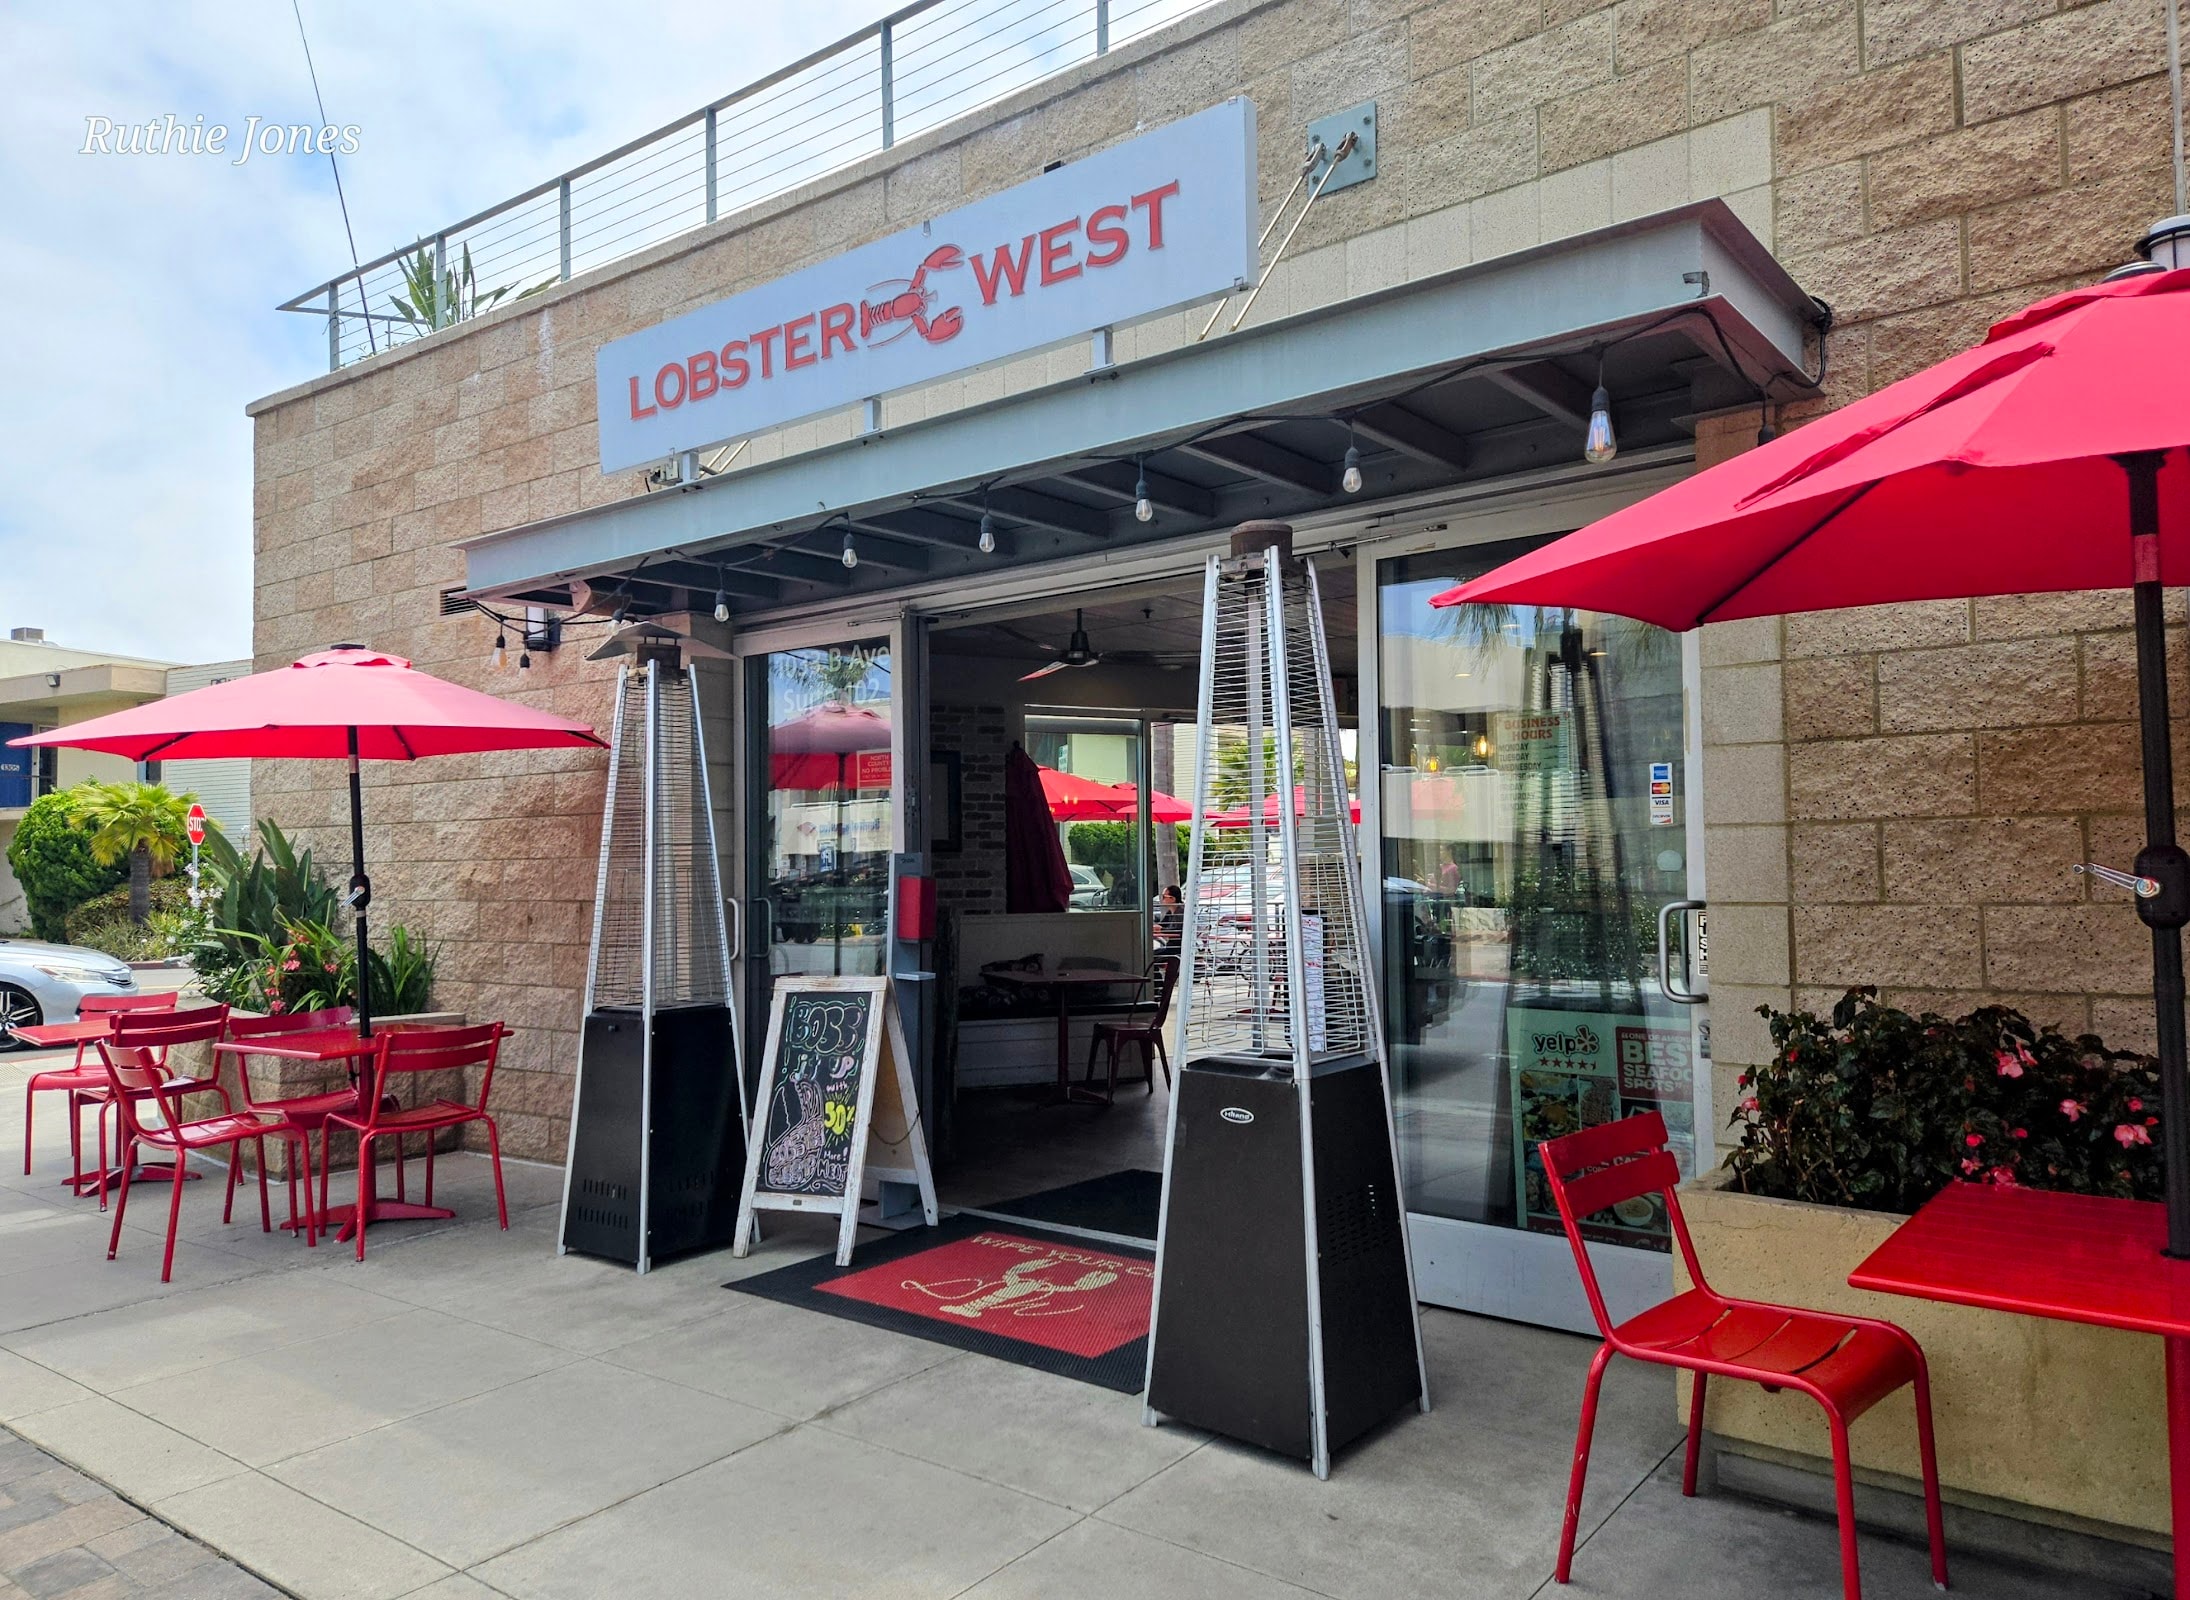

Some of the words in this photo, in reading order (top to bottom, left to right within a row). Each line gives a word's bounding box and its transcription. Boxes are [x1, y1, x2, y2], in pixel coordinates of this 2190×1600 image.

[628, 301, 858, 421] LOBSTER
[969, 178, 1180, 306] WEST
[829, 647, 841, 672] B
[848, 644, 890, 670] Ave
[1504, 716, 1560, 730] BUSINESS
[1512, 729, 1553, 741] HOURS
[1500, 742, 1529, 751] MONDAY
[1499, 753, 1530, 761] TUESDAY
[1535, 1033, 1576, 1055] yelp
[971, 1235, 1043, 1254] WIPE
[1048, 1249, 1123, 1270] YOUR
